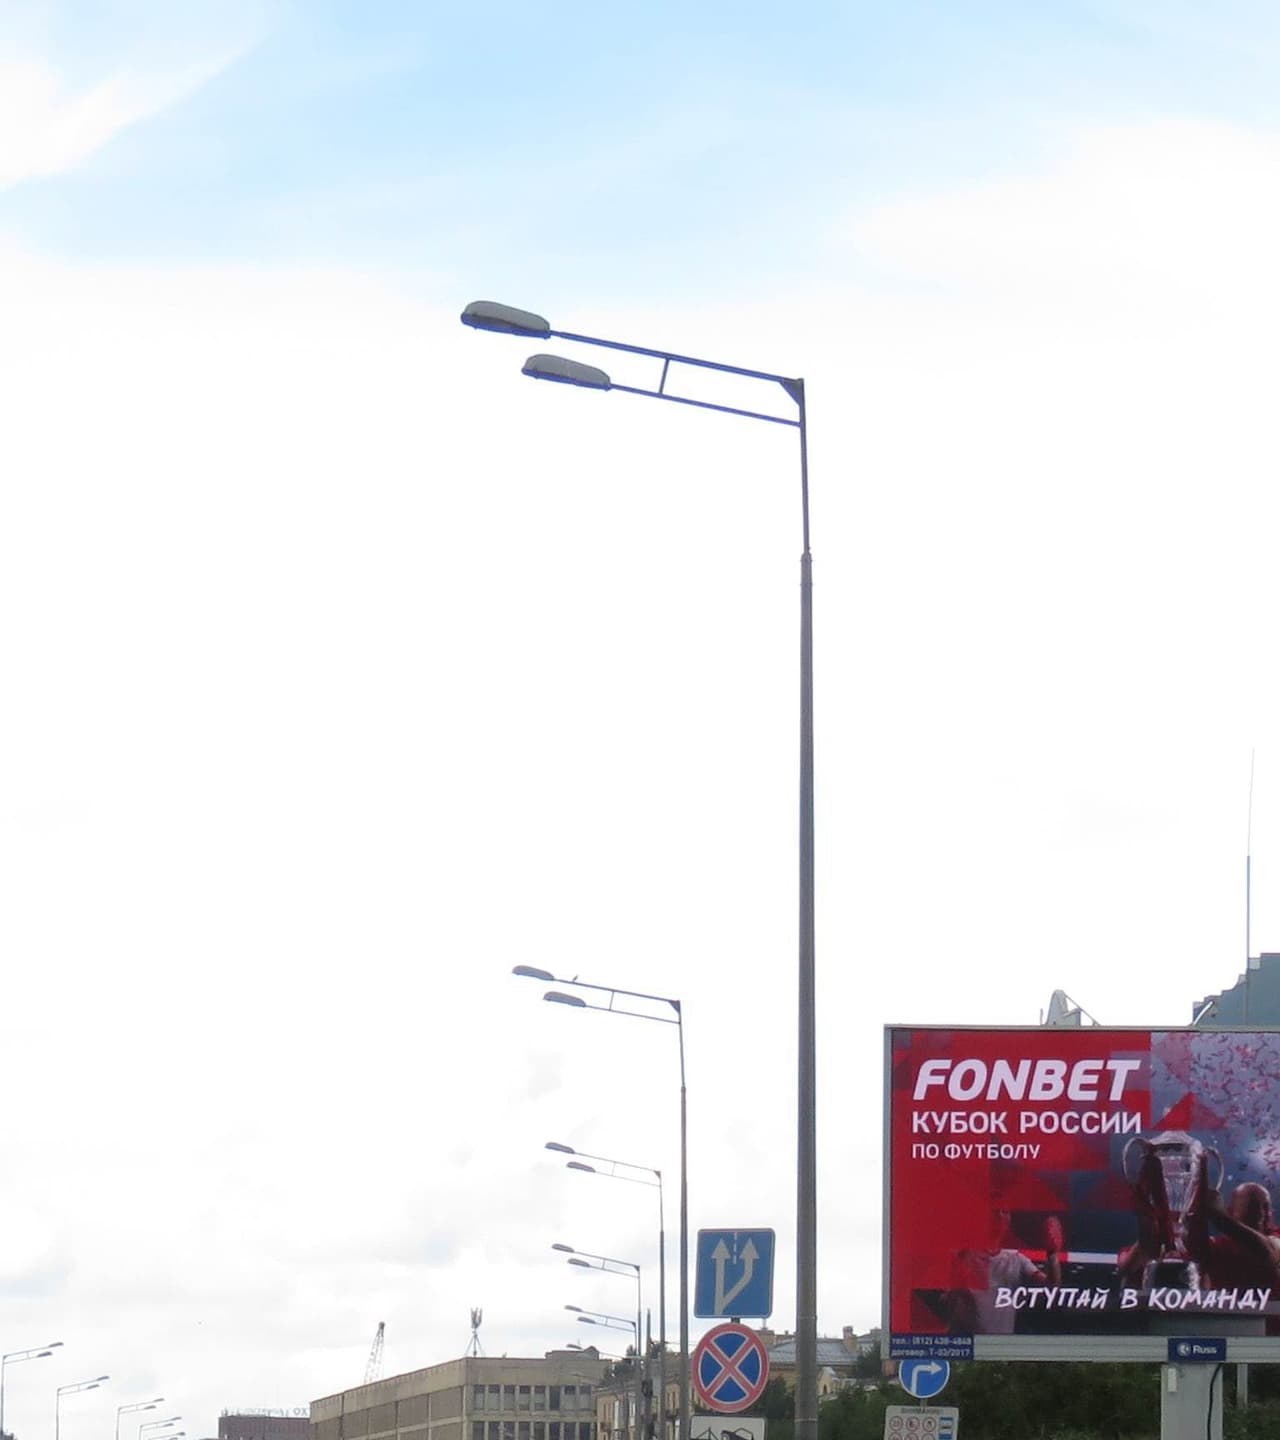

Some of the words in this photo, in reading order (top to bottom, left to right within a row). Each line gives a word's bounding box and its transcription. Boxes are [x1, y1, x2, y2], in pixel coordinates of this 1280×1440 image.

[912, 1058, 1142, 1101] FONBET
[912, 1111, 1008, 1134] КУБОК
[1020, 1111, 1142, 1134] РОССИИ
[912, 1143, 939, 1159] ПО
[944, 1143, 1041, 1159] ФУТБОЛУ
[995, 1286, 1110, 1310] ВСТУПАЙ
[1120, 1288, 1138, 1309] В
[1148, 1286, 1271, 1310] КОМАНДУ
